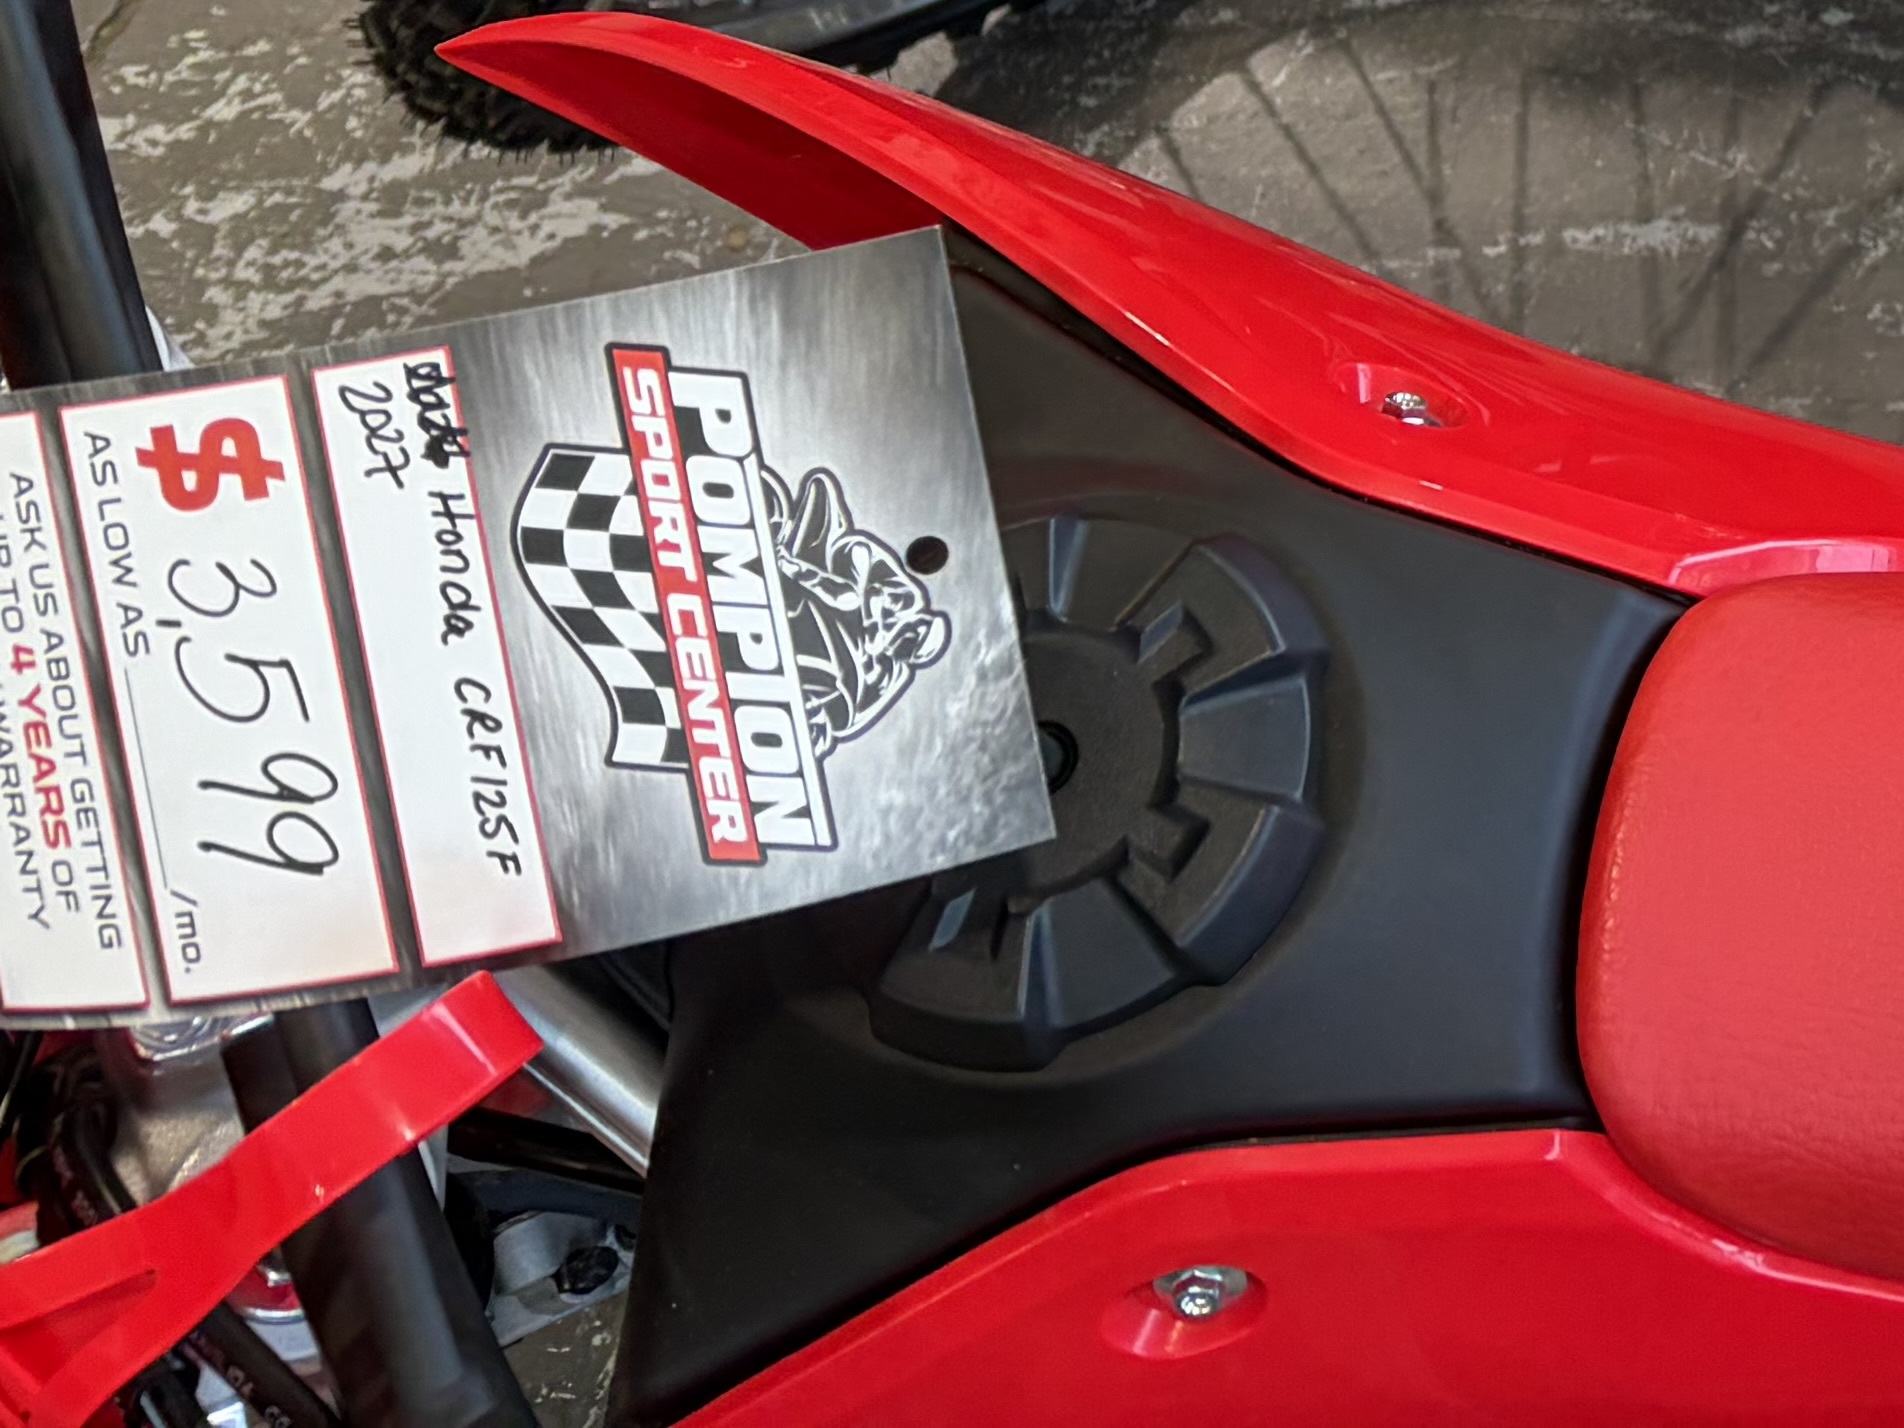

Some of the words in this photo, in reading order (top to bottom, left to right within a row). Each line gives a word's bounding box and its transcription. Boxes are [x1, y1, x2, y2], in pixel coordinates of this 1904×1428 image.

[83, 430, 119, 486] AS
[135, 415, 287, 514] $
[337, 380, 411, 490] 2027
[10, 472, 47, 553] ASK
[97, 496, 138, 589] LOW
[1, 577, 25, 634] TO
[28, 563, 59, 617] US
[427, 490, 482, 647] Honda
[622, 364, 699, 586] SPORT
[666, 590, 749, 846] CENTER
[667, 370, 818, 847] POMPION
[10, 643, 37, 676] 4
[116, 600, 152, 659] AS
[39, 628, 88, 766] ABOUT
[155, 557, 340, 877] 3,599
[17, 682, 72, 850] YEARS
[51, 859, 81, 914] OF
[69, 776, 123, 951] GETTING
[168, 886, 203, 974] /mo.
